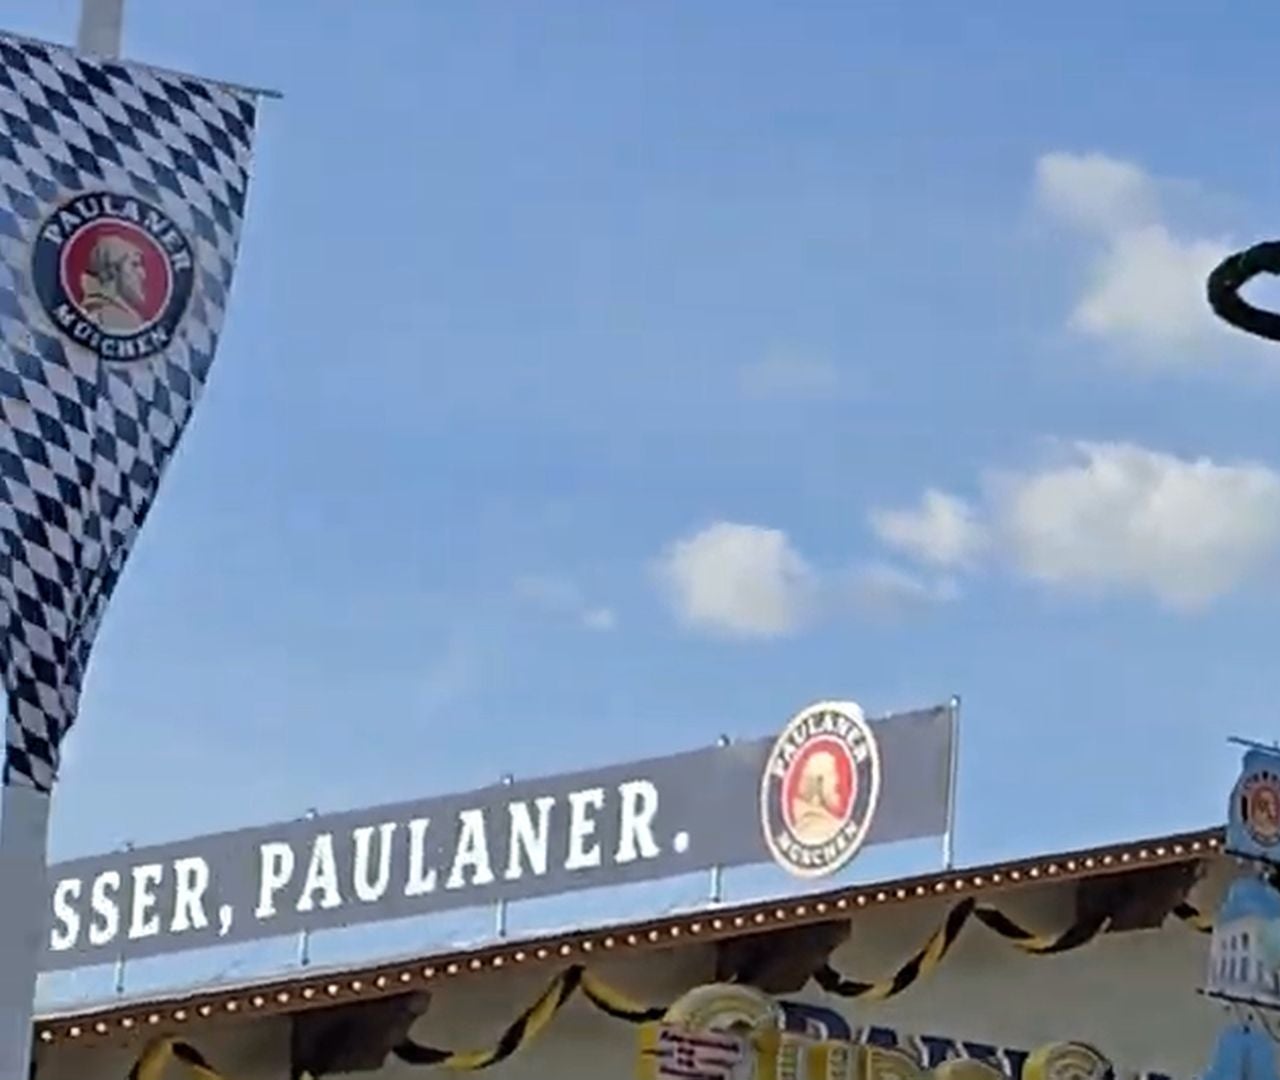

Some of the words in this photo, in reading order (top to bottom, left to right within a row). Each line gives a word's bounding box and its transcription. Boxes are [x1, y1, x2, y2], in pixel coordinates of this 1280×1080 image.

[43, 197, 191, 272] PAULANER
[771, 711, 868, 778] PAULANER
[50, 857, 233, 951] SSER,
[255, 780, 689, 919] PAULANER.
